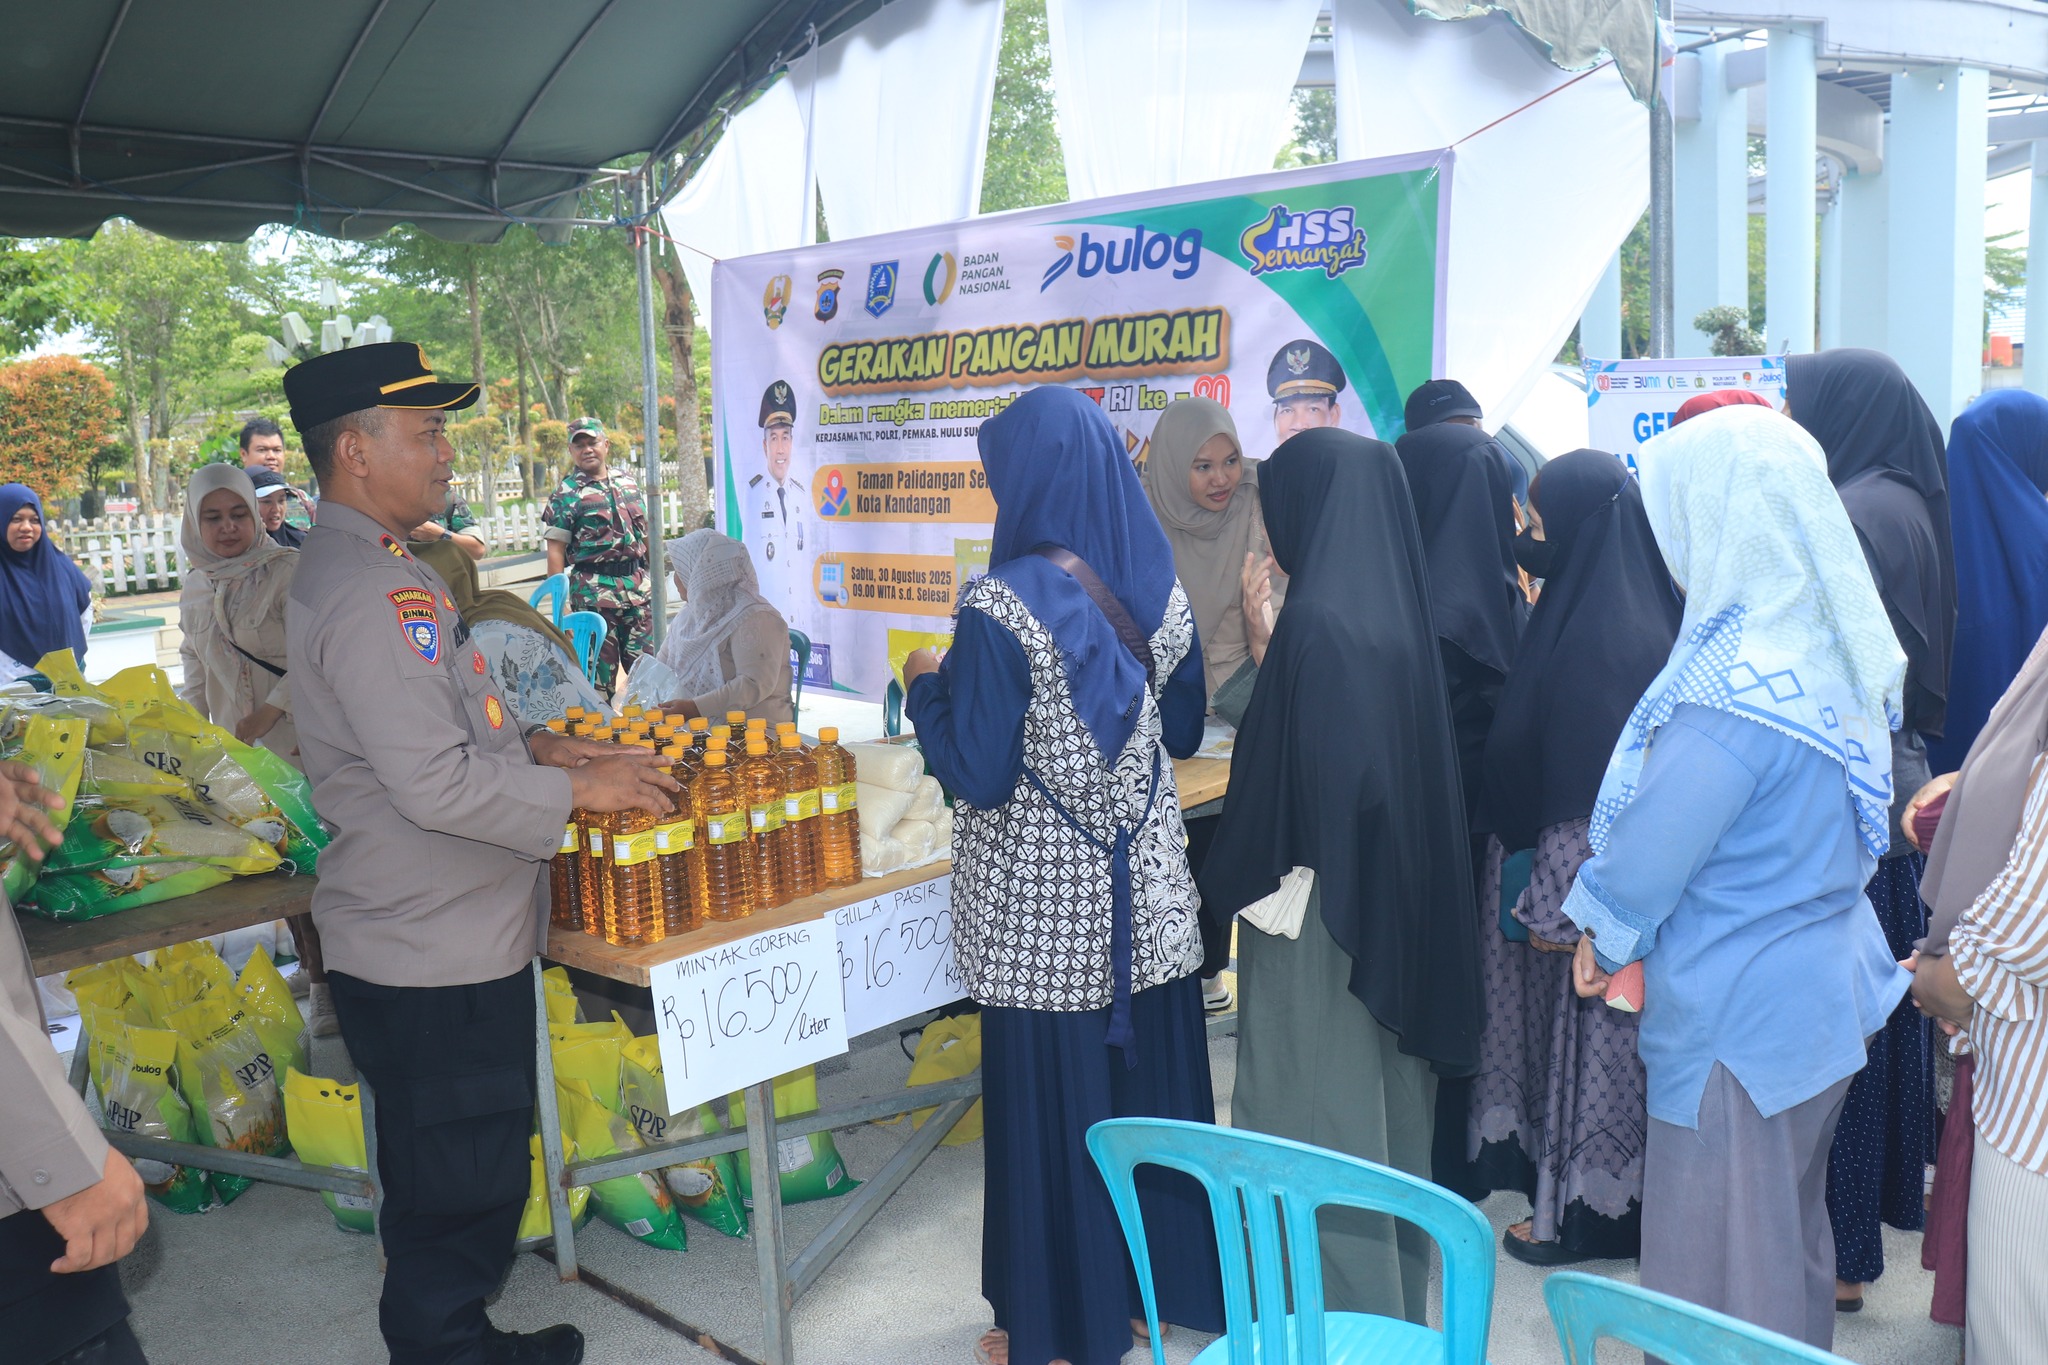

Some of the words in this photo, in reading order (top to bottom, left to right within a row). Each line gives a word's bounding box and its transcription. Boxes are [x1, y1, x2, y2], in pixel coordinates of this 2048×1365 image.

[1276, 208, 1353, 248] HSS
[1078, 223, 1202, 280] bulog
[1241, 211, 1363, 275] Semangat
[963, 252, 999, 266] BADAN
[961, 266, 1004, 281] PANGAN
[959, 279, 1011, 295] NASIONAL
[818, 336, 949, 386] GERAKAN
[950, 319, 1086, 378] PANGAN
[1087, 308, 1223, 367] MURAH
[819, 403, 863, 425] Dalam
[867, 398, 925, 426] rangka
[1109, 385, 1133, 412] RI
[1138, 384, 1168, 410] ke
[815, 432, 858, 443] KERJASAMA
[860, 431, 875, 442] TNI,
[875, 428, 901, 442] POLRI,
[902, 427, 939, 440] PEMKAB.
[940, 427, 962, 438] HULU
[857, 471, 894, 490] Taman
[897, 469, 965, 491] Palidangan
[856, 494, 881, 514] Kota
[885, 494, 951, 516] Kandangan
[851, 566, 876, 583] Sabtu,
[878, 568, 889, 581] 30
[891, 568, 926, 585] Agustus
[929, 570, 951, 585] 2025
[393, 591, 432, 603] BAHARKAM
[852, 585, 875, 599] 09.00
[877, 586, 897, 600] WITA
[898, 587, 915, 602] s.d.
[917, 587, 950, 603] Selesai
[402, 610, 434, 620] BINMAS
[835, 899, 882, 926] GULA
[894, 882, 943, 910] PASIR
[676, 951, 747, 980] MINYAK
[749, 929, 811, 957] GORENG
[662, 995, 695, 1079] Rp
[136, 1064, 161, 1075] bulog
